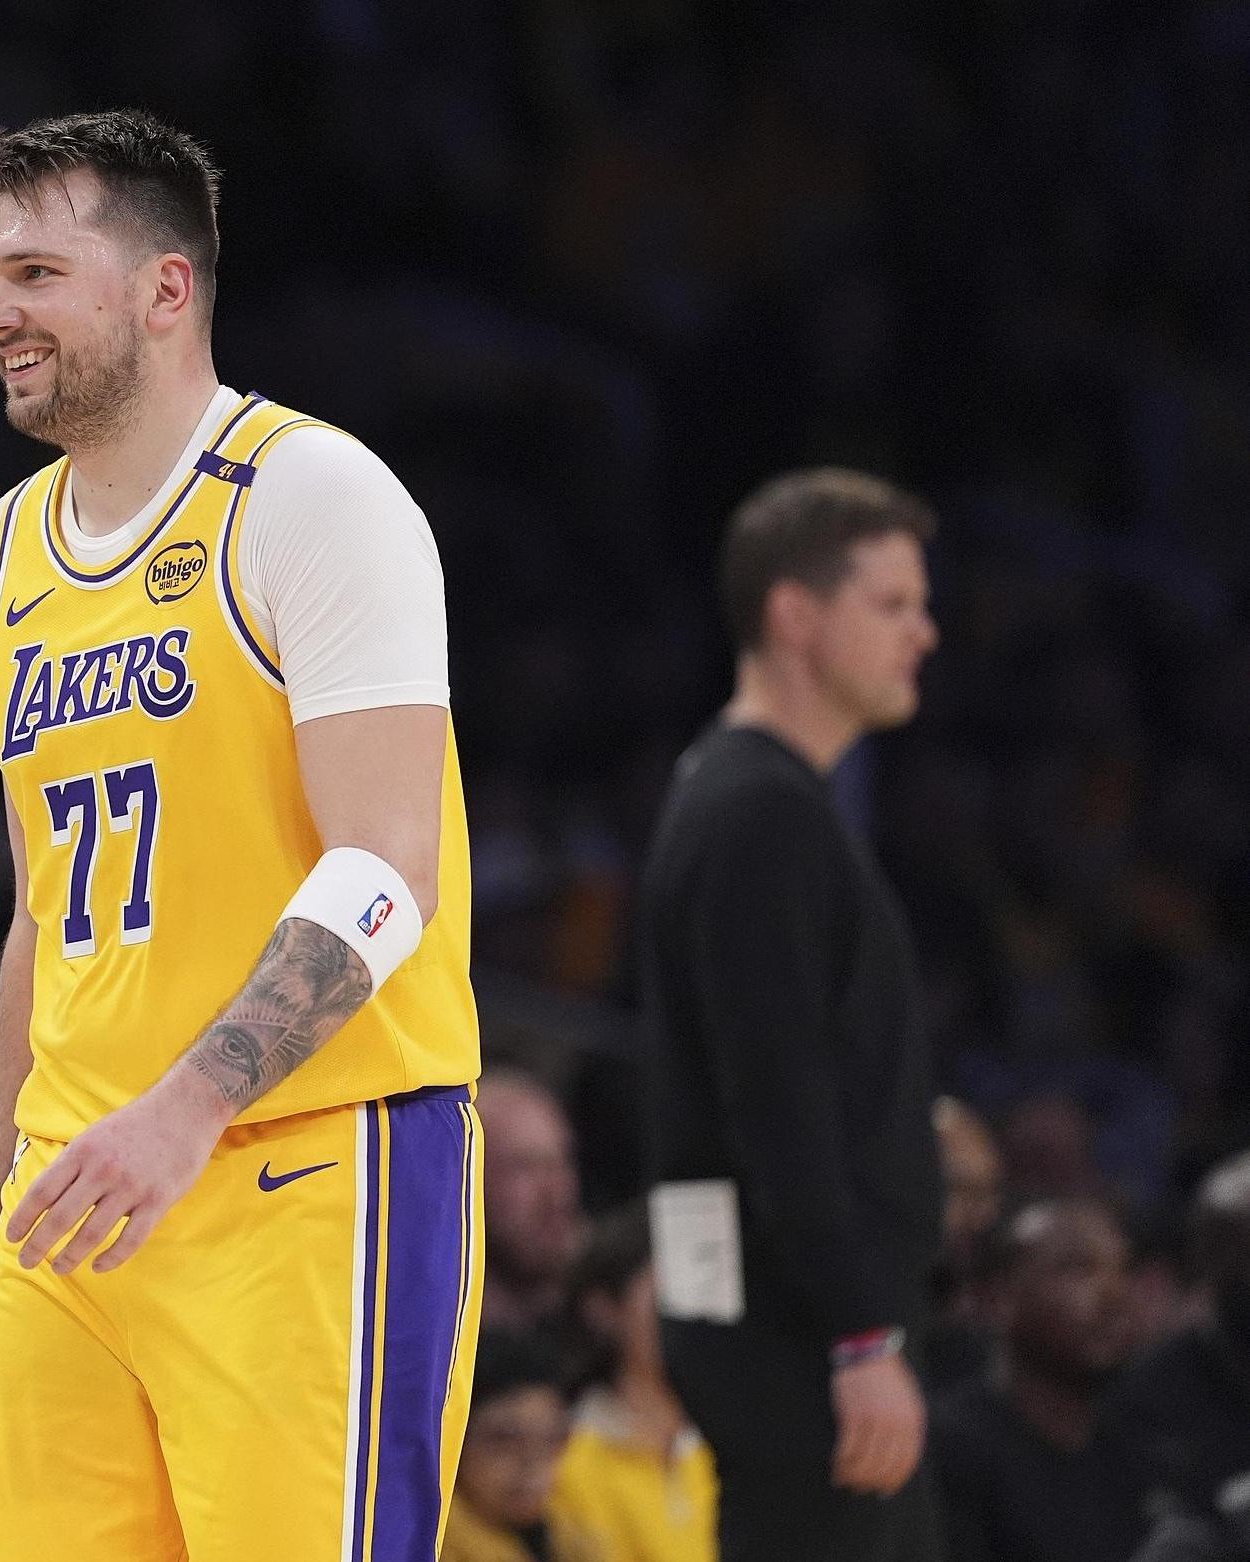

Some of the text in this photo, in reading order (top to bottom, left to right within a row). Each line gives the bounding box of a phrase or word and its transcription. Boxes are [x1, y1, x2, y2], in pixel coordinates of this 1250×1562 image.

[218, 462, 238, 479] 44
[151, 556, 204, 582] bibigo
[158, 577, 180, 591] 비비고
[0, 627, 197, 764] LAKERS
[40, 758, 161, 959] 77
